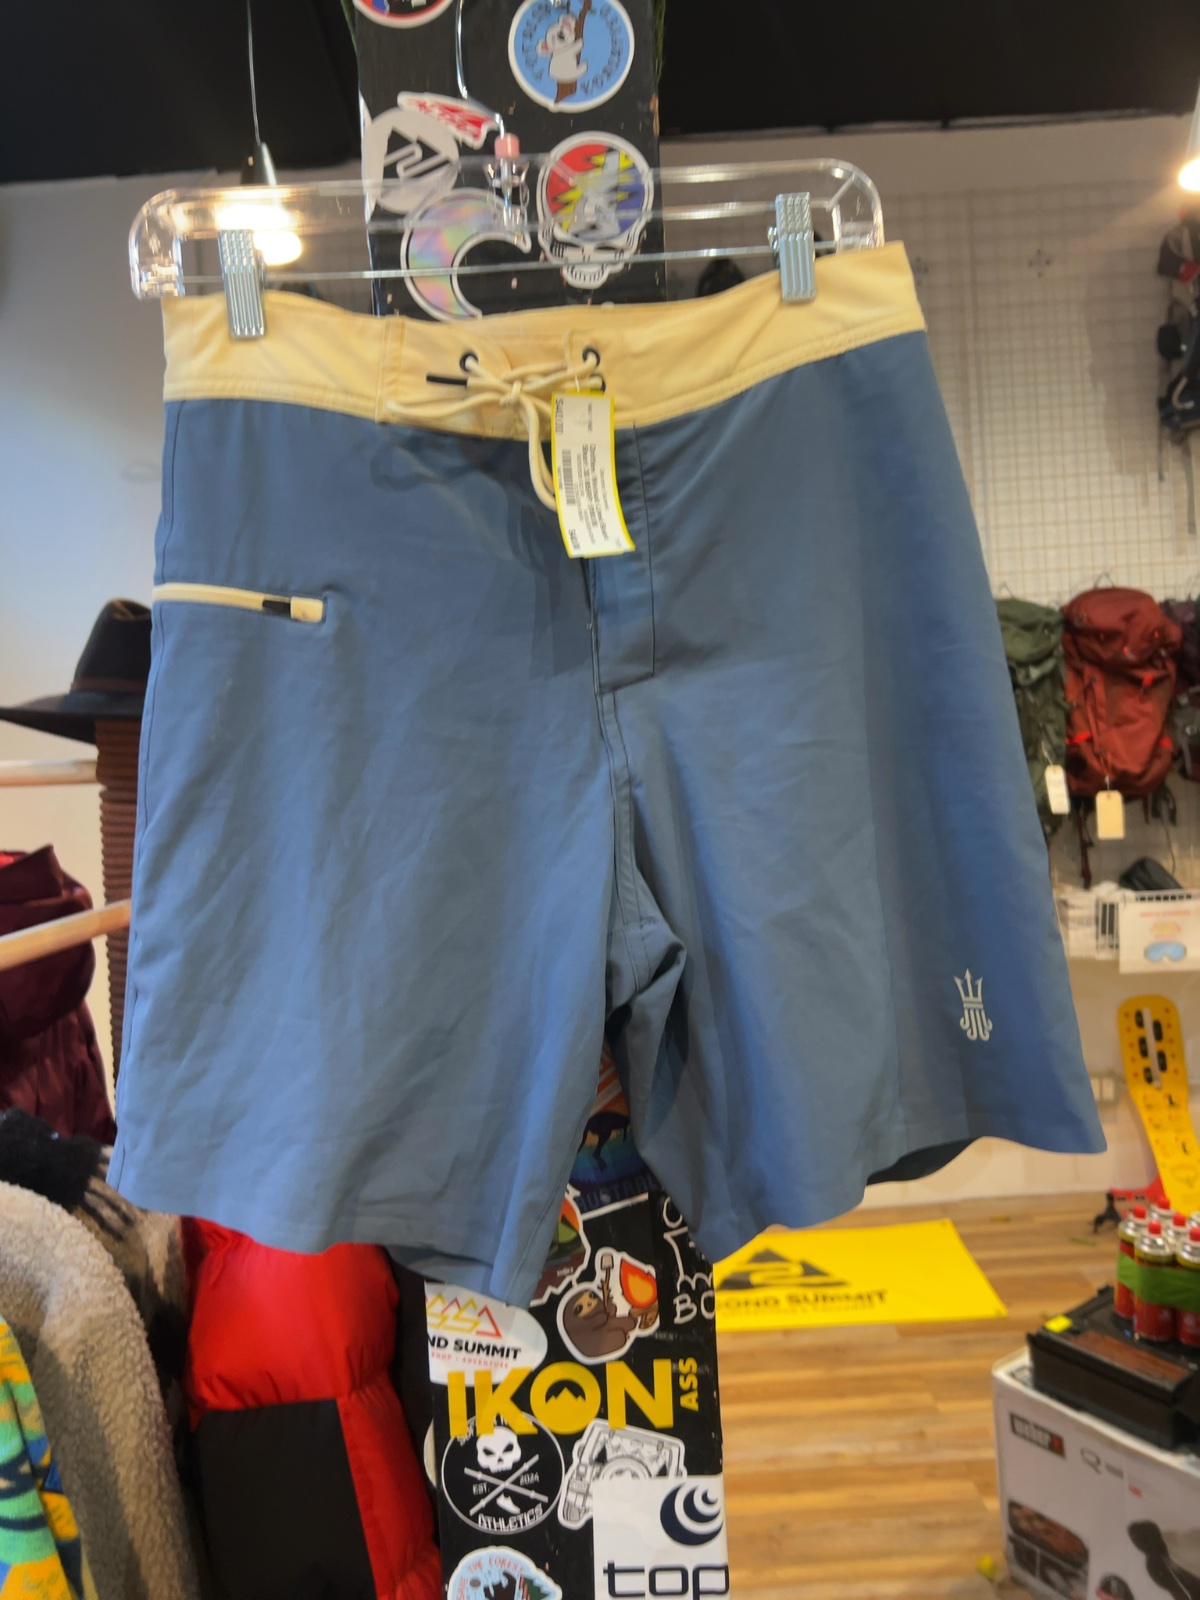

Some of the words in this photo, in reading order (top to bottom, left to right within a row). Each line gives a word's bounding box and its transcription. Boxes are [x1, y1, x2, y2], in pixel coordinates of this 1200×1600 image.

[453, 1337, 522, 1360] SUMMIT
[447, 1358, 674, 1437] IKON
[678, 1356, 699, 1412] ASS
[477, 1502, 544, 1532] ATHLETICS
[602, 1560, 730, 1600] top
